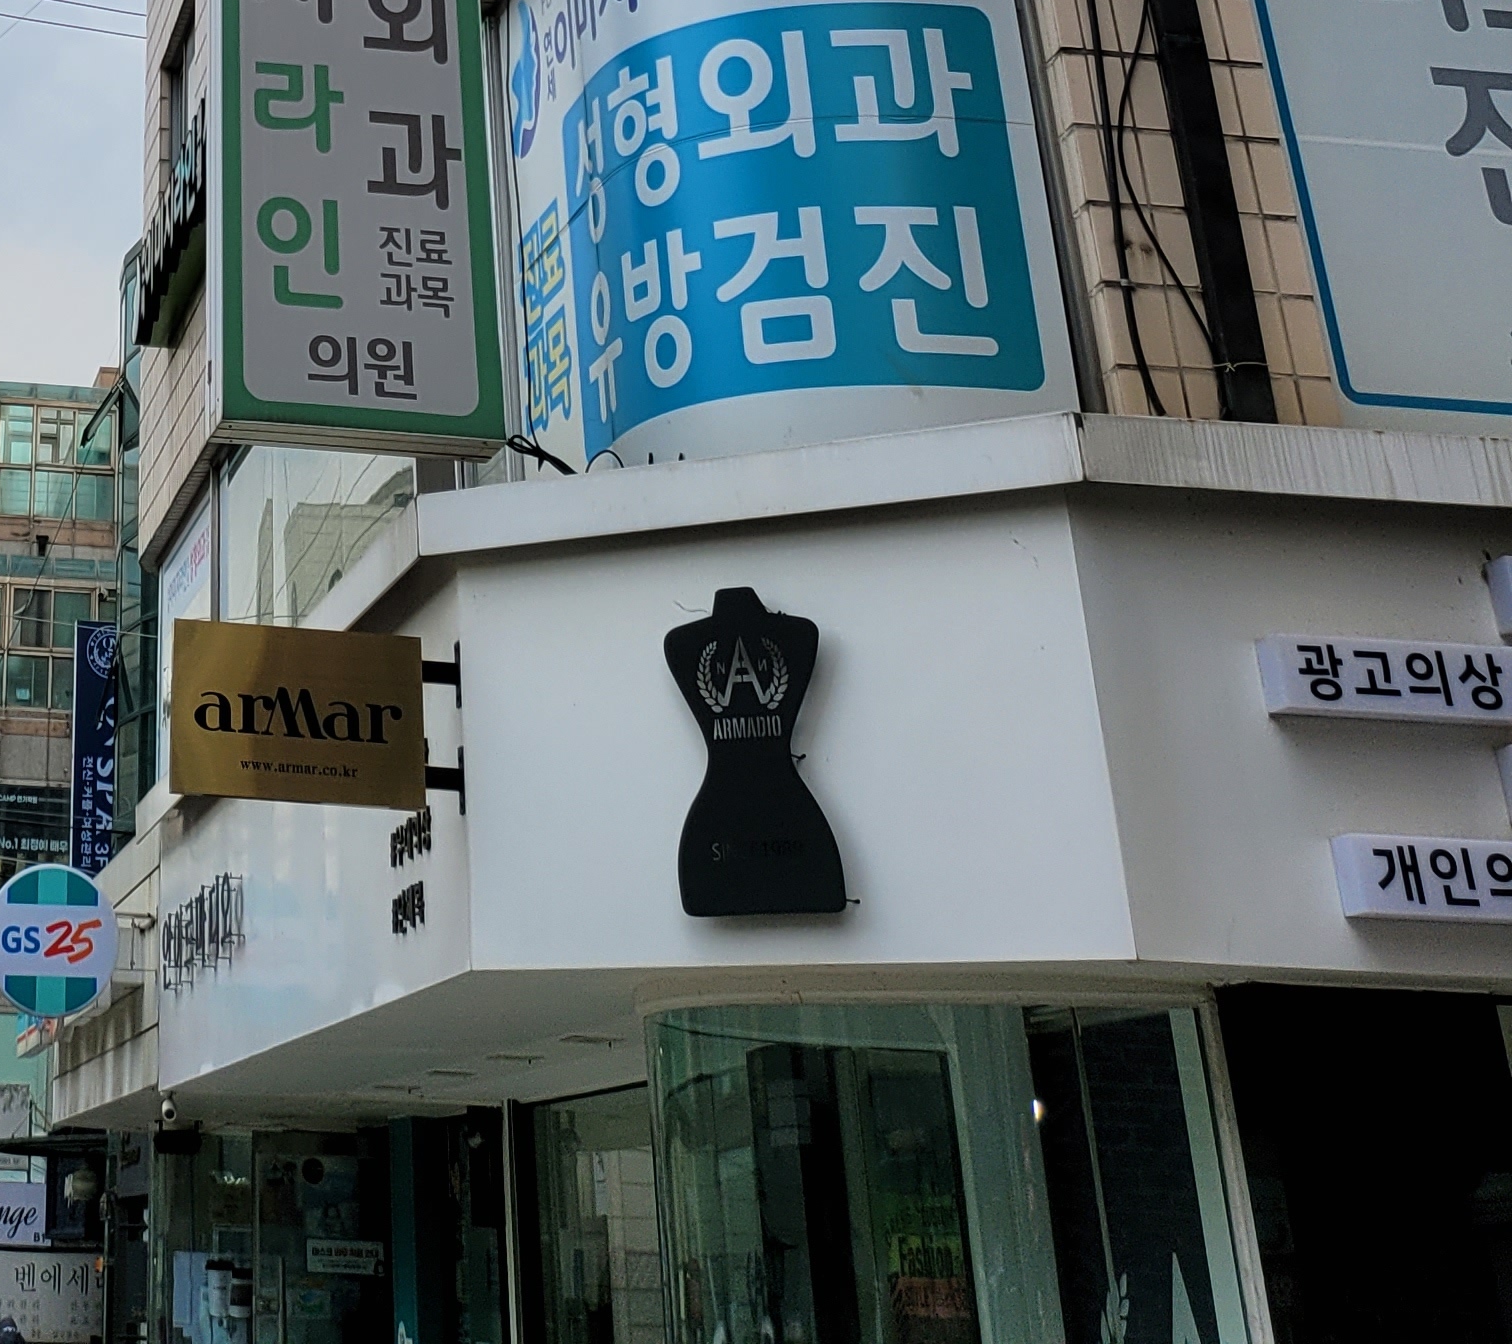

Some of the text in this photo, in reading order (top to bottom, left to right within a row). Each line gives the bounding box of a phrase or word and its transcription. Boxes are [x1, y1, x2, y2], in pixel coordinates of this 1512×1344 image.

[574, 26, 975, 244] 성형외과
[377, 224, 454, 271] 진료
[377, 267, 456, 320] 과목
[589, 204, 1001, 424] 유방검진
[307, 332, 419, 402] 의원
[1296, 641, 1505, 713] 광고의상
[712, 714, 783, 741] ARMADIO
[239, 757, 359, 781] www.armar.co.kr
[0, 918, 103, 964] GS25
[14, 1262, 105, 1296] 벤에세
